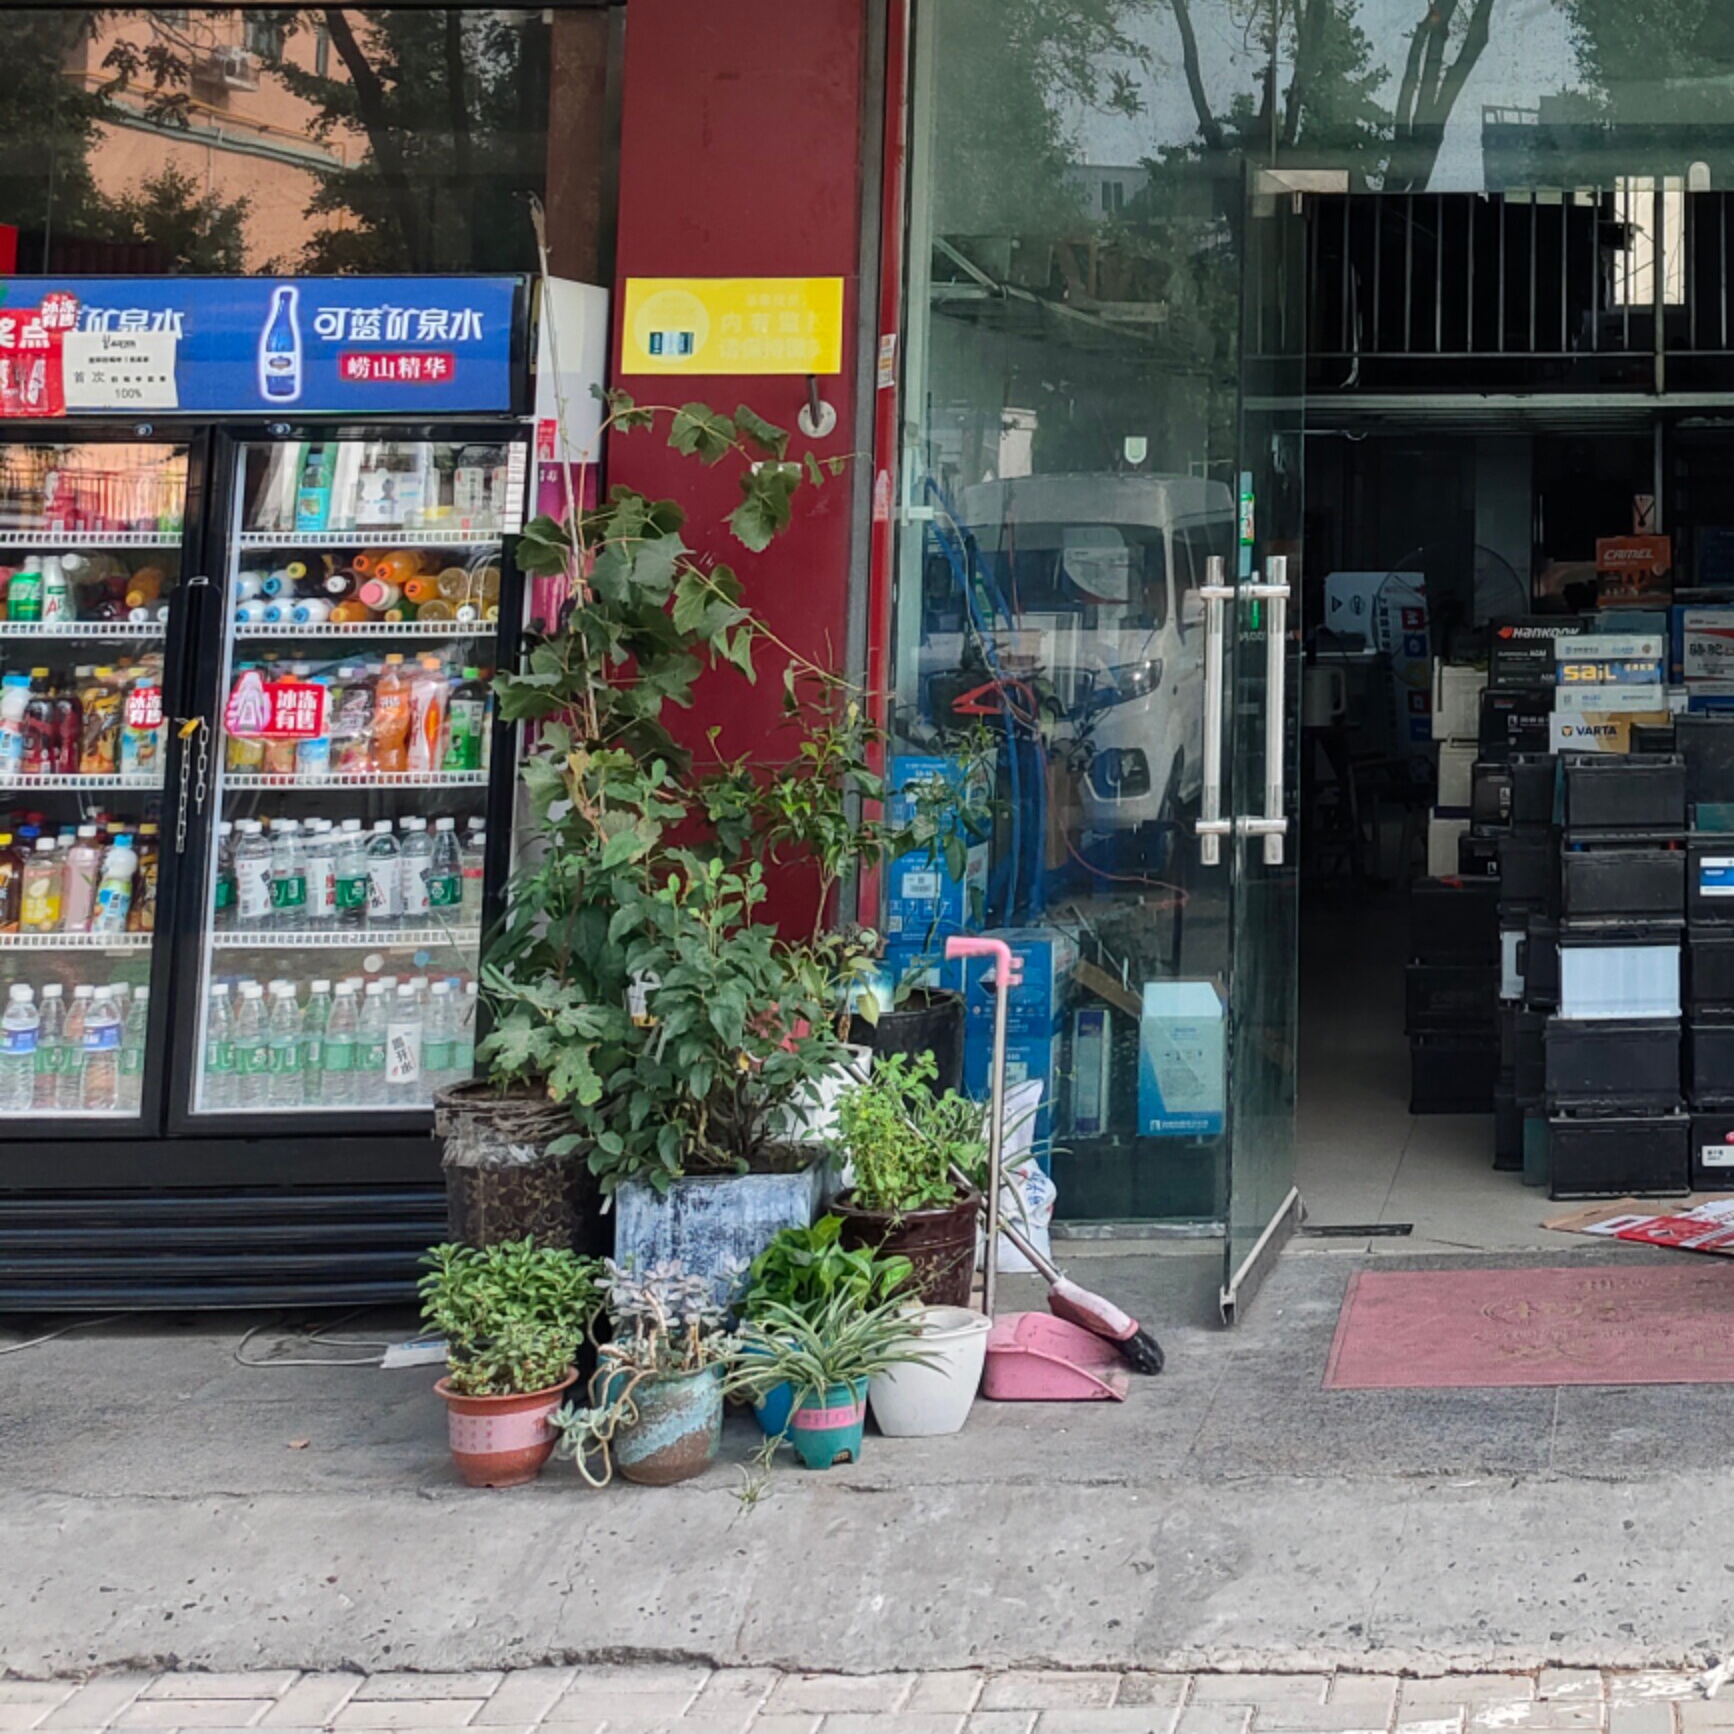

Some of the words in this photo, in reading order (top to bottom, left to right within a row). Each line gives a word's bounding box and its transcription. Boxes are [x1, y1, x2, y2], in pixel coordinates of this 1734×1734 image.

[314, 307, 484, 341] 可蓝矿泉水
[347, 356, 447, 379] 崂山精华
[275, 689, 318, 709] 冰冻
[276, 709, 316, 730] 有售
[1575, 725, 1618, 737] VARTA
